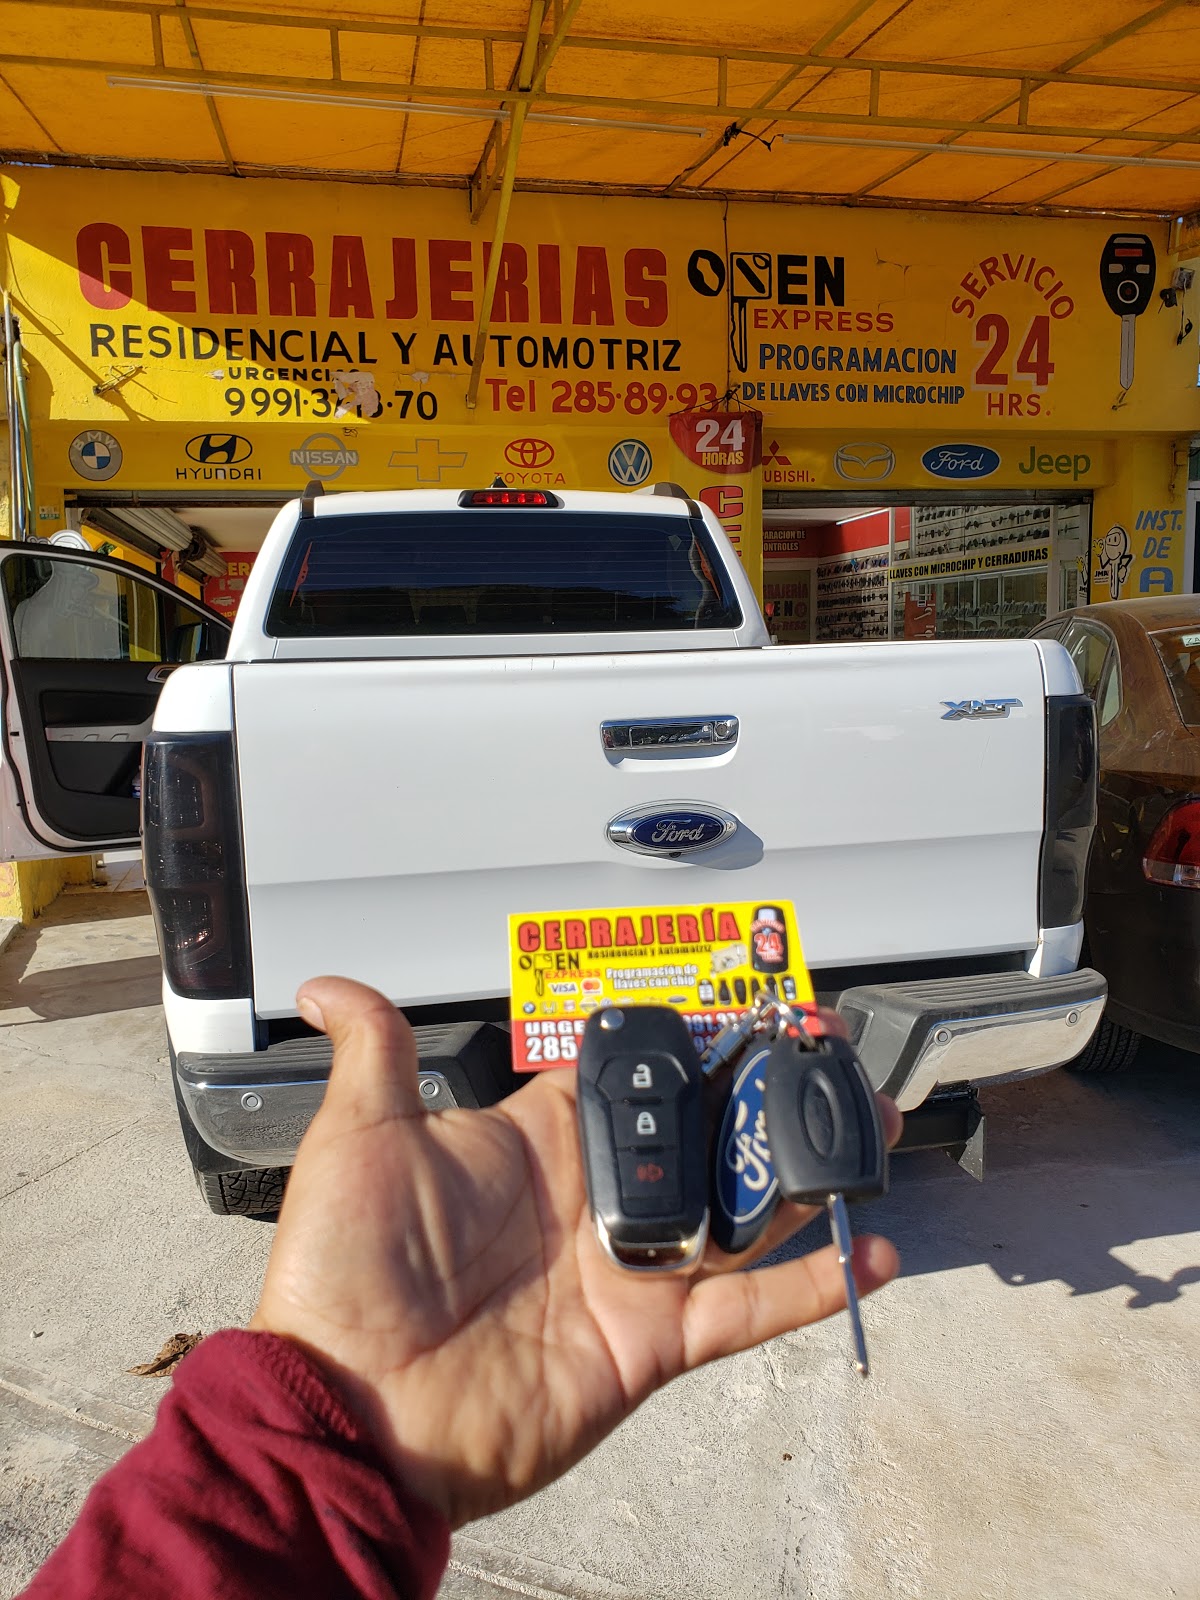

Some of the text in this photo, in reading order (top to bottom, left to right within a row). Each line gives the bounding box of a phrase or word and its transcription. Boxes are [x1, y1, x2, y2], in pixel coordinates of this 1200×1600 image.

[76, 222, 669, 328] CERRAJERIAS
[951, 253, 1075, 320] SERVICIO
[753, 308, 894, 333] EXPRESS
[89, 323, 682, 372] RESIDENCIAL Y AUTOMOTRIZ
[759, 343, 957, 374] PROGRAMACION
[971, 313, 1055, 394] 24
[228, 366, 361, 382] URGENCI
[485, 378, 536, 412] Tel
[742, 382, 965, 405] DE LLAVES CON MICROCHIP
[986, 393, 1051, 417] HRS.
[73, 431, 117, 451] BMW
[695, 419, 746, 452] 24
[292, 451, 357, 465] NISSAN
[702, 451, 744, 466] HORAS
[930, 452, 984, 471] Ford
[1018, 446, 1091, 481] Jeep
[176, 467, 261, 480] HYUNDAI
[763, 470, 816, 483] UBISHI.
[1135, 510, 1183, 531] INST.
[762, 530, 796, 540] ARACION
[763, 542, 799, 551] ONTROLES
[1143, 537, 1171, 559] DE
[889, 547, 1049, 579] LLAVES CON MICROCHIP Y CERRADURAS
[1139, 567, 1174, 593] A
[940, 698, 1023, 721] XLT
[651, 818, 705, 843] Ford
[518, 908, 741, 953] CERRAJERÍA
[754, 932, 783, 954] 24
[545, 968, 601, 979] EXPRESS
[683, 964, 698, 974] de
[550, 983, 577, 993] VISA
[648, 977, 669, 988] con
[670, 975, 696, 986] chip
